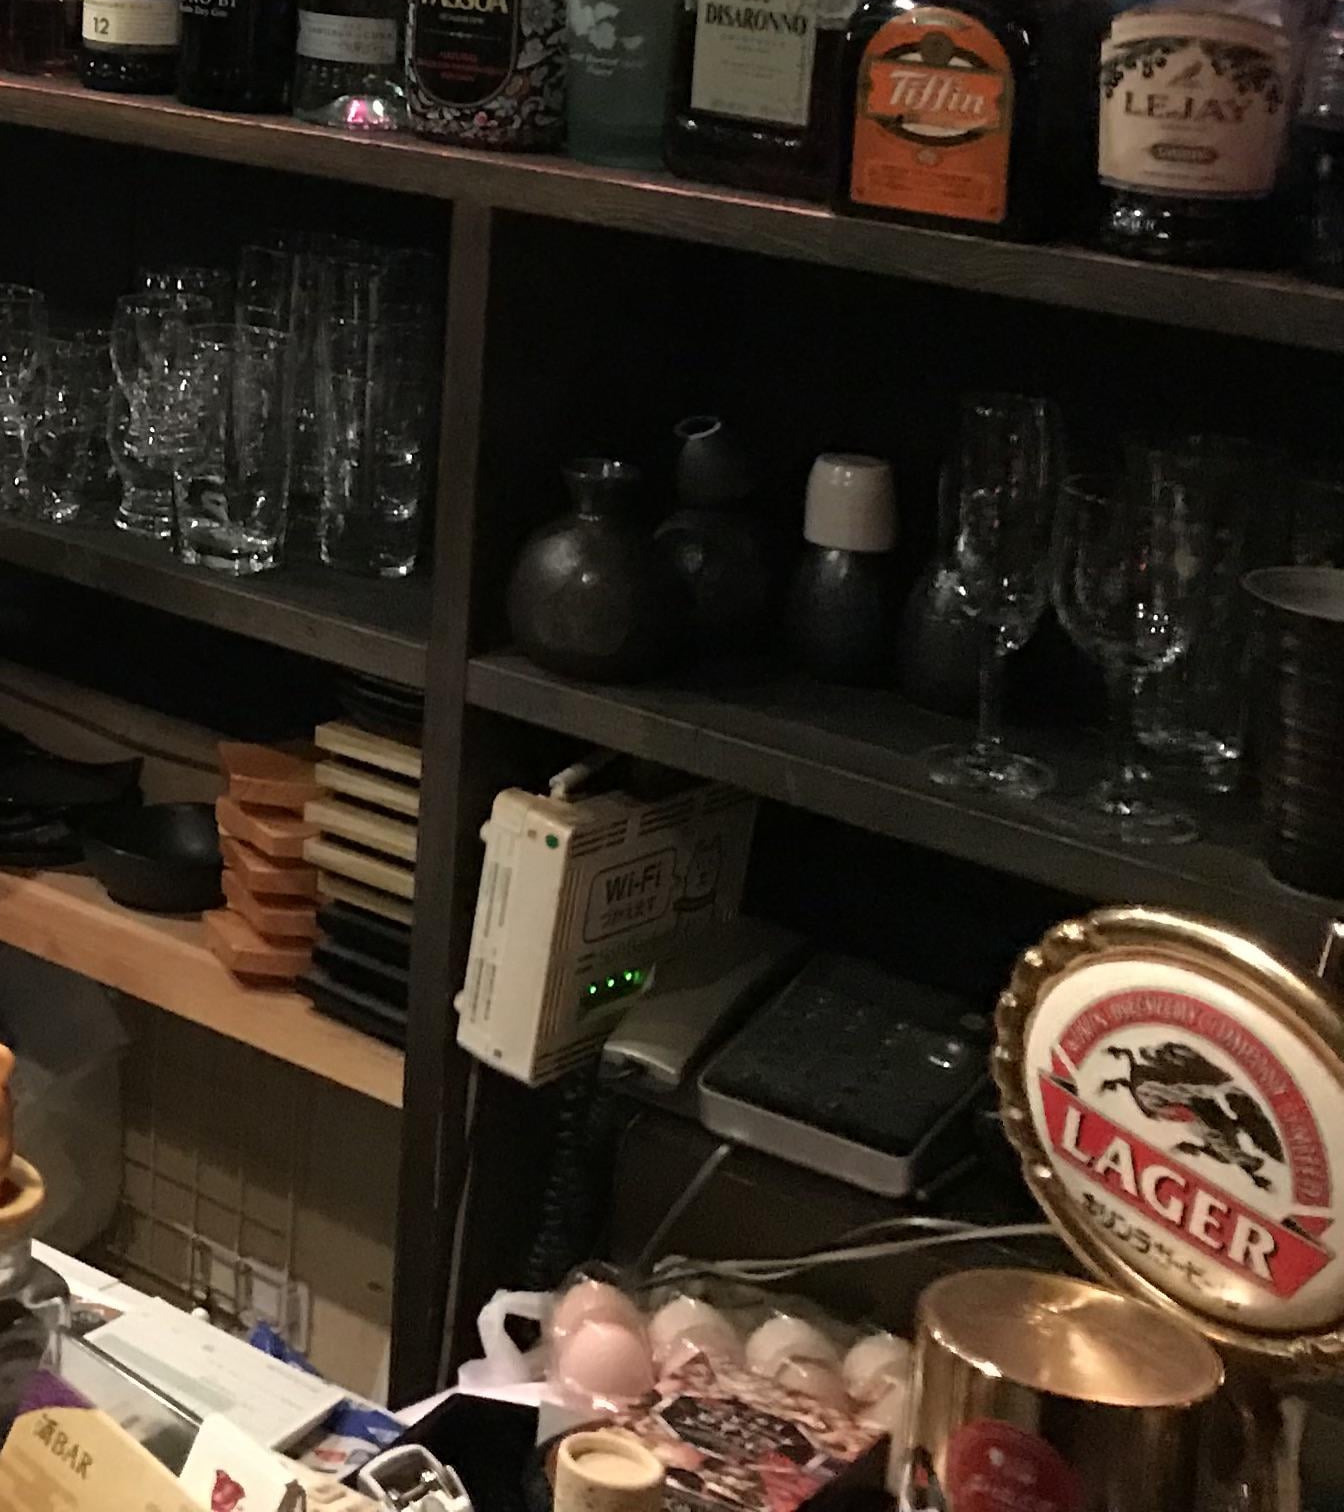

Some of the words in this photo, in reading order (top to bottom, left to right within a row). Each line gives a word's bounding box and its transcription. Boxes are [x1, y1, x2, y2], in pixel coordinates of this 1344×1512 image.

[93, 17, 110, 35] 12
[705, 2, 807, 36] DISARONNO
[889, 70, 985, 115] Tiffin
[1124, 90, 1254, 123] LEJAY
[606, 862, 662, 905] Wi-Fi
[1062, 1109, 1280, 1282] LAGER
